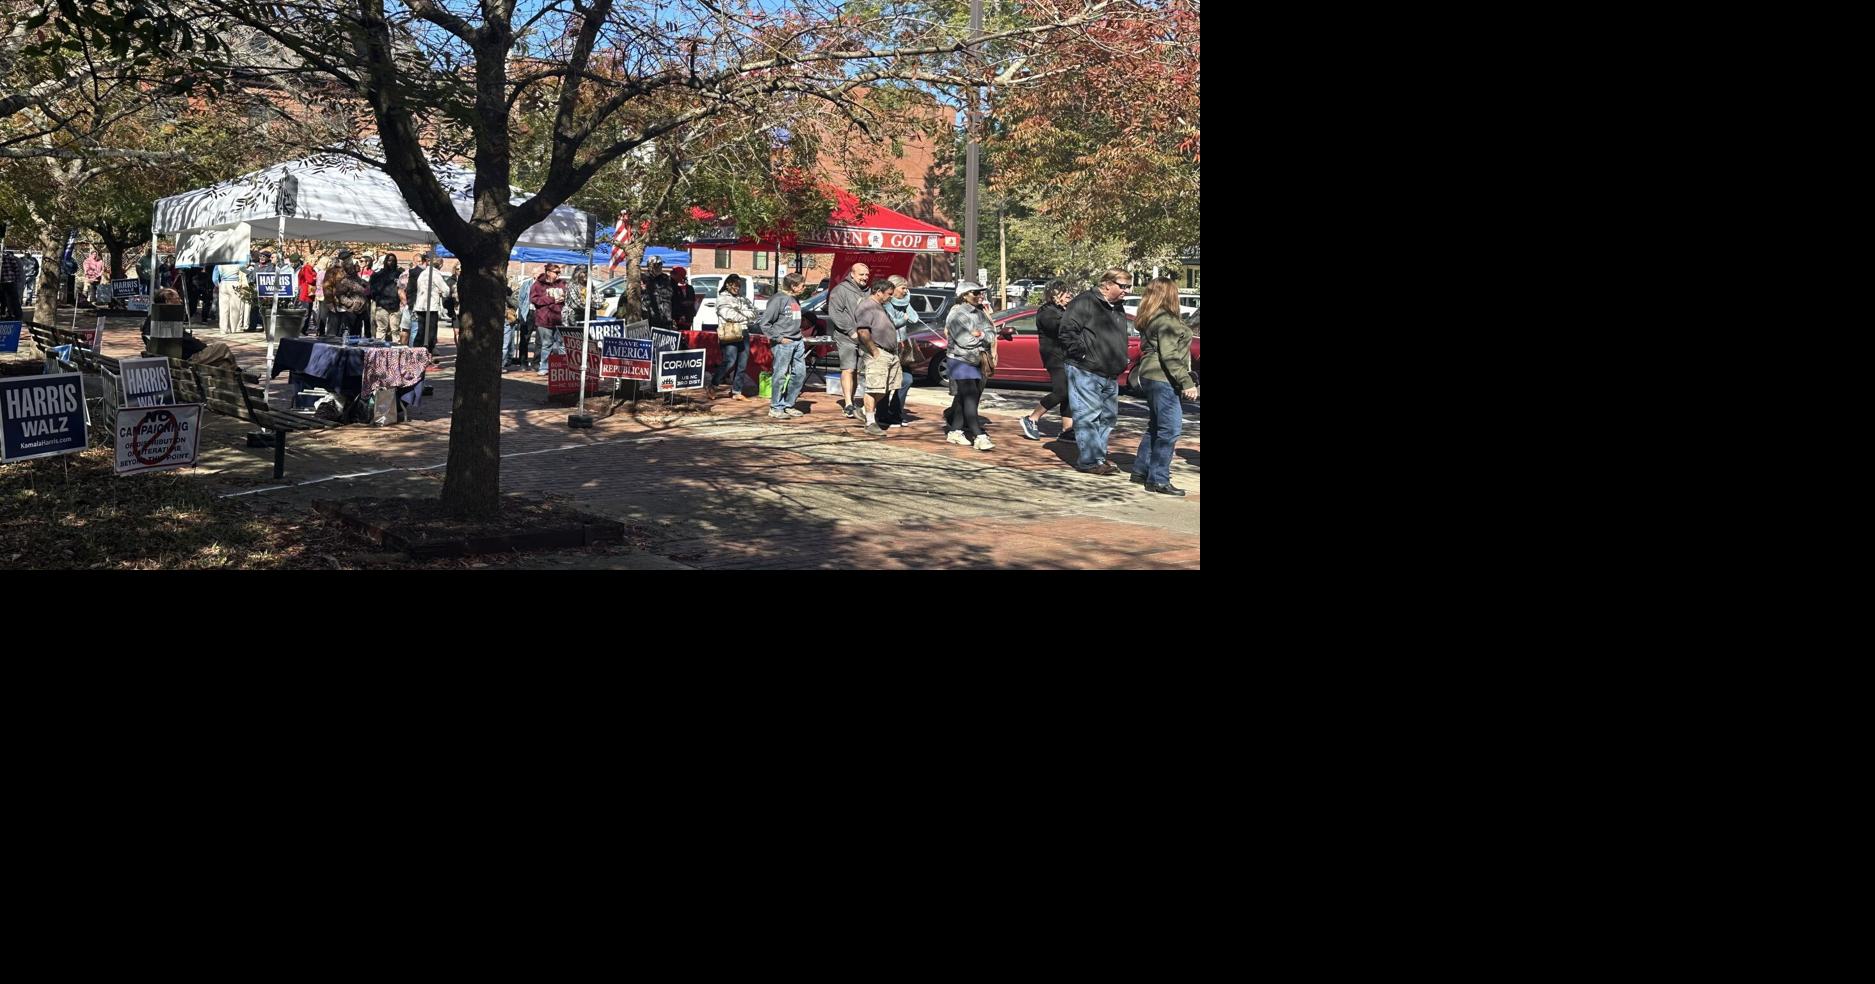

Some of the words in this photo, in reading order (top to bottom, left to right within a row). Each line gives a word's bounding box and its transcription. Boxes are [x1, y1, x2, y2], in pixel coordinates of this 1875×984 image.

[806, 230, 863, 244] RAVEN
[890, 234, 922, 248] GOP
[113, 280, 138, 290] HARRIS
[259, 275, 291, 286] HARIS
[589, 324, 621, 341] ARRIS
[652, 332, 677, 351] HARRIS
[605, 345, 649, 359] AMERICA
[602, 364, 650, 376] REPUBLICAN
[663, 358, 703, 370] CORMOS
[125, 366, 169, 395] HARRIS
[551, 368, 593, 382] BRINS
[5, 383, 78, 420] HARRIS
[137, 394, 166, 407] WALZ
[144, 411, 170, 424] NO
[21, 416, 69, 438] WALZ
[20, 436, 72, 449] KamalaHarris.com
[166, 452, 190, 461] POINT
